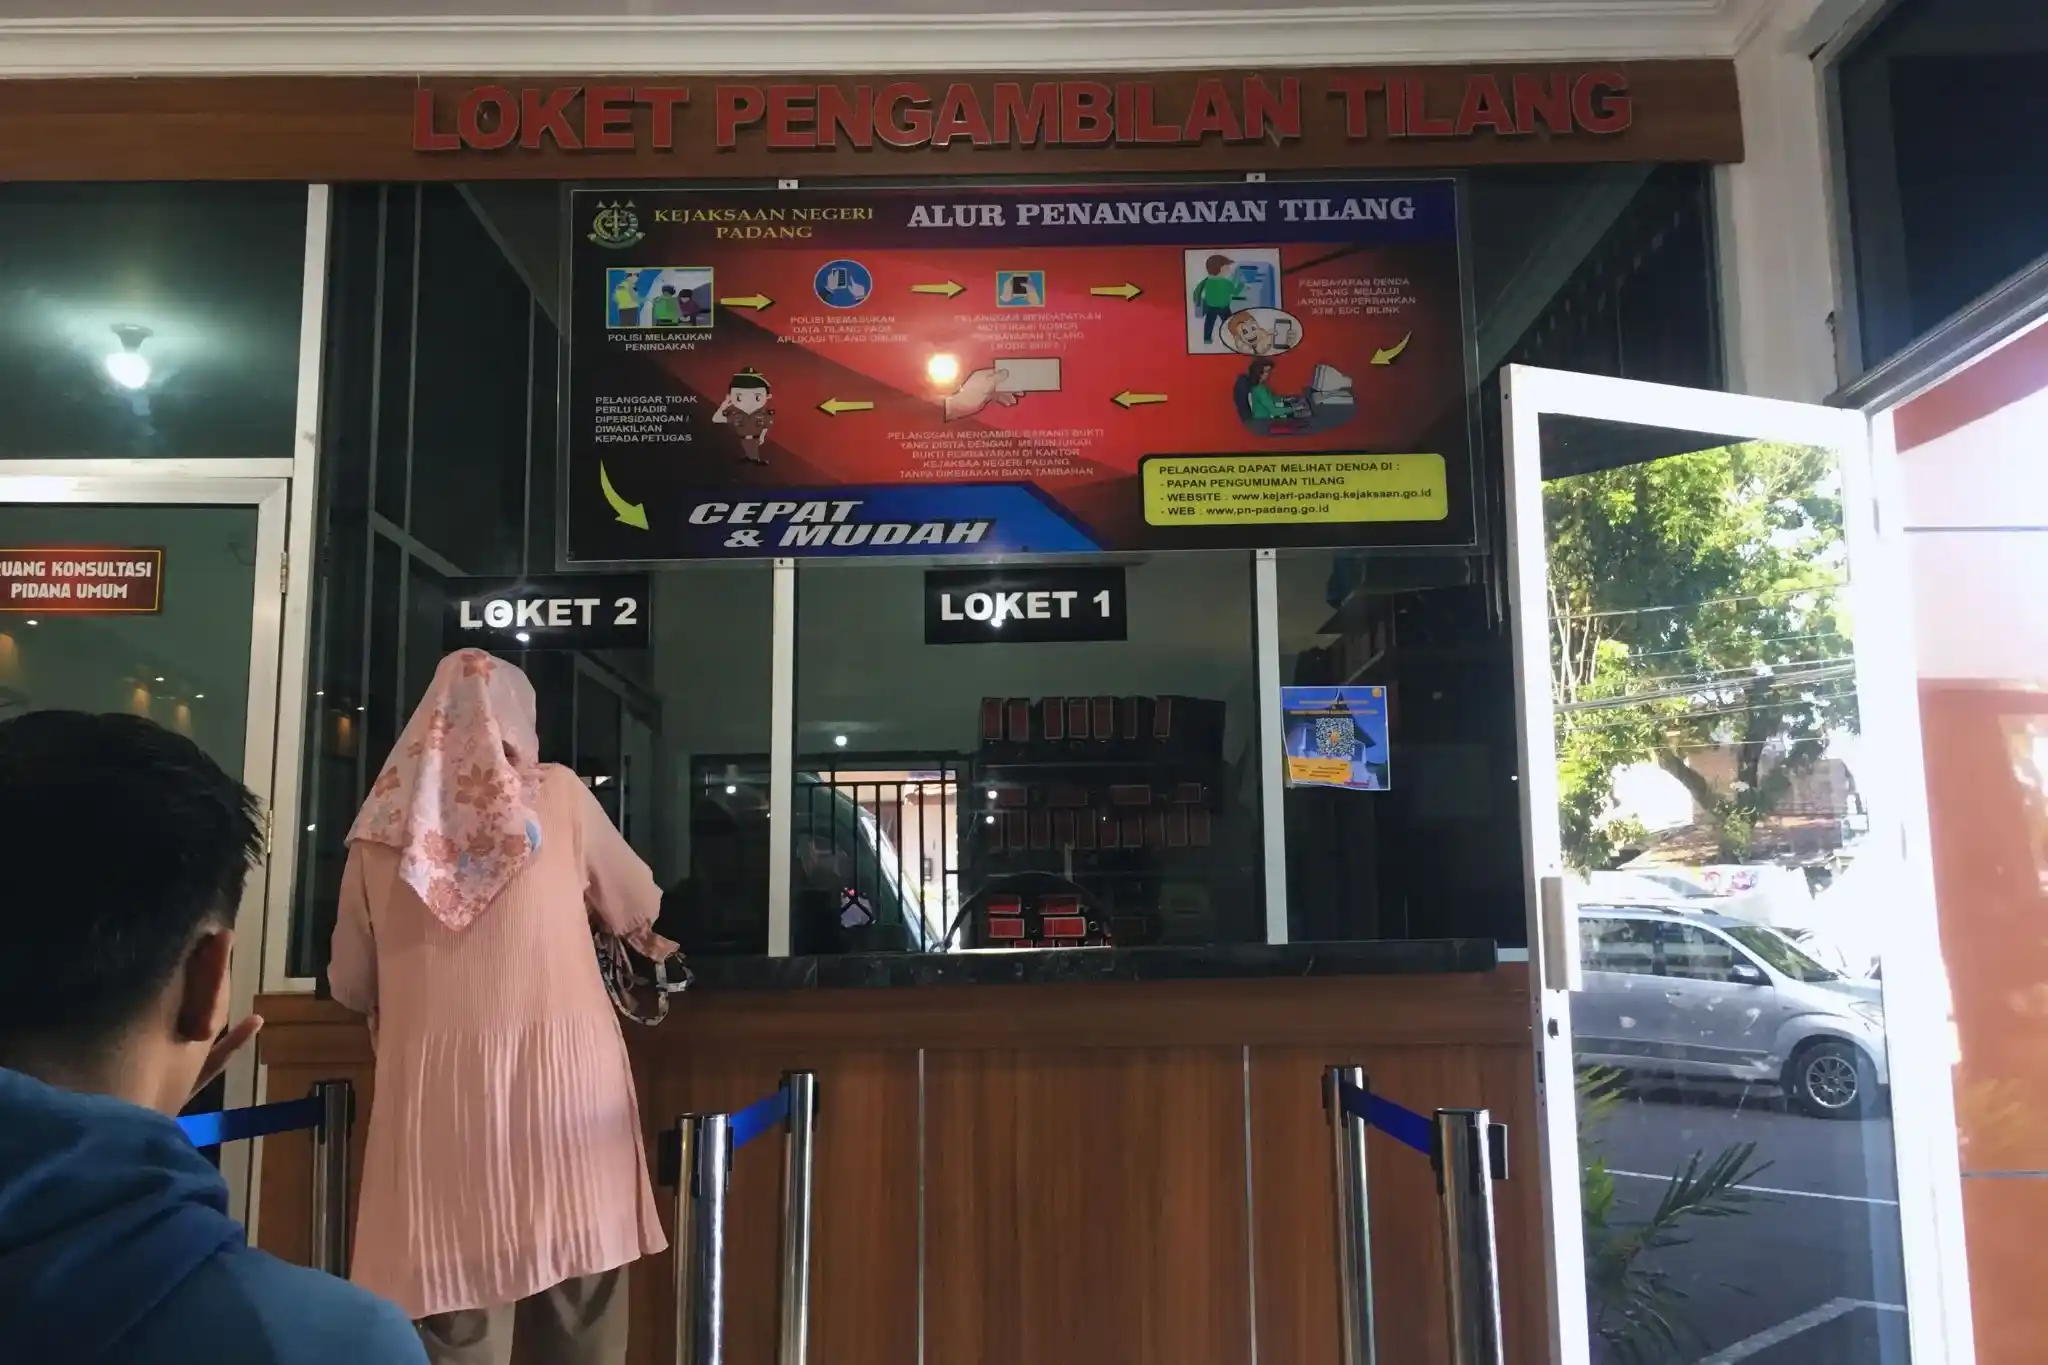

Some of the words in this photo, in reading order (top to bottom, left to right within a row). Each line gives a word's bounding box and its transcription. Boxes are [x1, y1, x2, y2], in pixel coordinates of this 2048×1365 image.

[412, 85, 690, 151] LOKET
[716, 74, 1300, 148] PENGAMBILAN
[1327, 71, 1632, 137] TILANG
[654, 208, 785, 224] KEJAKSAAN
[791, 207, 874, 220] NEGERI
[907, 204, 1005, 227] ALUR
[1016, 200, 1267, 226] PENANGANAN
[1279, 197, 1415, 222] TILANG
[716, 226, 813, 239] PADANG
[1373, 277, 1410, 286] DENDA
[1310, 287, 1349, 297] TILANG
[1353, 287, 1400, 295] MELALUI
[790, 315, 824, 324] POLISI
[793, 325, 820, 334] DATA
[823, 325, 861, 334] TILANG
[645, 333, 712, 341] MELAKUKAN
[776, 335, 825, 344] APLIKASI
[828, 334, 867, 343] TILANG
[625, 343, 695, 351] PENINDAKAN
[595, 396, 662, 404] PELANGGAR
[665, 395, 698, 404] TIDAK
[595, 405, 631, 413] PERLU
[634, 405, 667, 413] HADIR
[595, 415, 683, 423] DIPERSIDANGAN
[595, 424, 662, 433] DIWAKILKAN
[595, 434, 639, 442] KEPADA
[641, 434, 692, 442] PETUGAS
[957, 430, 1020, 439] MENGAMBIL
[900, 441, 929, 450] YANG
[932, 441, 965, 449] DISITA
[967, 440, 1012, 448] DENGAN
[912, 451, 944, 459] BUKTI
[1022, 449, 1032, 457] DI
[1035, 448, 1080, 457] KANTOR
[983, 459, 1022, 468] NEGERI
[1025, 458, 1070, 467] PADANG
[1159, 465, 1235, 474] PELANGGAR
[1238, 464, 1276, 473] DAPAT
[1280, 463, 1332, 473] MELIHAT
[1335, 462, 1378, 472] DENDA
[1380, 462, 1393, 471] DI
[900, 470, 934, 478] TANPA
[1001, 468, 1032, 477] BIAYA
[1167, 479, 1207, 488] PAPAN
[1210, 478, 1297, 488] PENGUMUMAN
[1300, 477, 1345, 486] TILANG
[1167, 492, 1221, 502] WEBSITE
[1231, 488, 1432, 502] www.kejari-padang.kejaksaan.go.id
[688, 500, 864, 525] CEPAT
[1167, 506, 1196, 516] WEB
[723, 529, 764, 547] &
[778, 522, 989, 547] MUDAH
[51, 561, 152, 577] KONSULTASI
[11, 583, 72, 598] PIDANA
[76, 583, 128, 599] UMUM
[941, 590, 1078, 621] LOKET
[1092, 590, 1110, 618] 1
[459, 598, 601, 628] LOKET
[613, 597, 637, 626] 2
